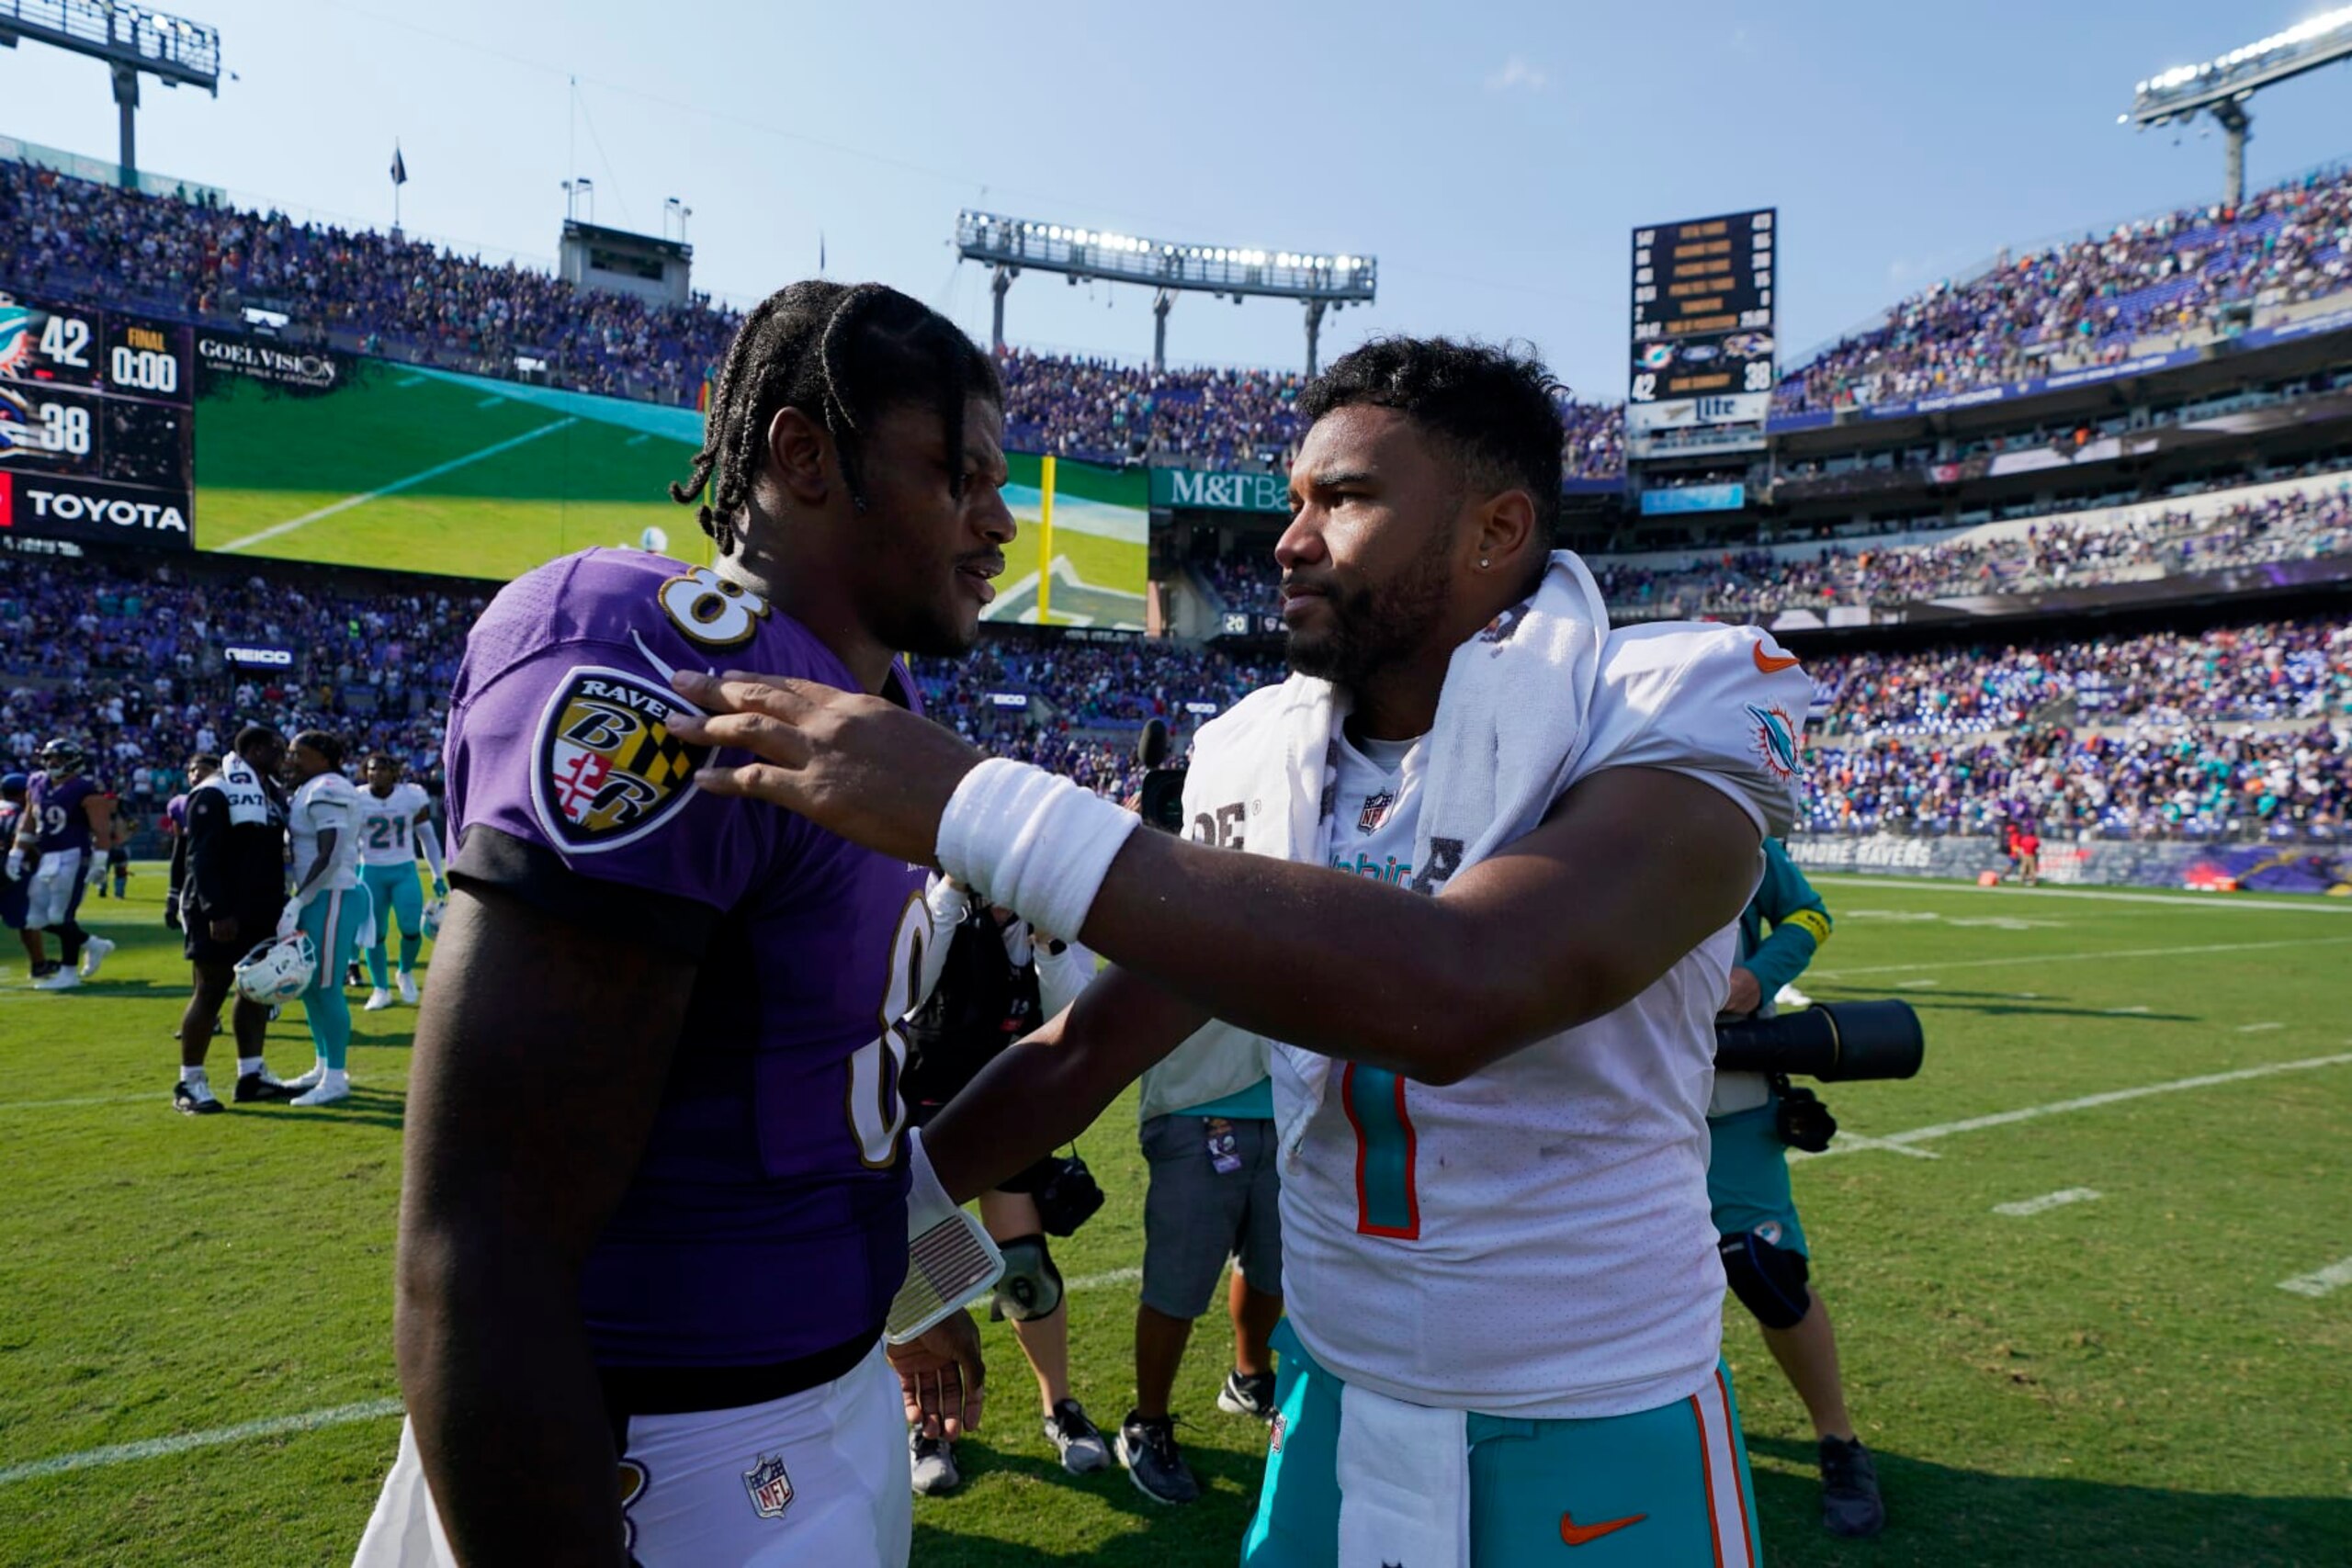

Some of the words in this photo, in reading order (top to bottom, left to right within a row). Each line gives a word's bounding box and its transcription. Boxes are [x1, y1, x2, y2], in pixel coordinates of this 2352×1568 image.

[40, 315, 90, 367] 42
[127, 327, 165, 351] FINAL
[112, 347, 176, 393] 0:00
[198, 338, 259, 366] GOEL
[260, 348, 336, 380] VISION
[1744, 361, 1771, 391] 38
[1632, 373, 1657, 401] 42
[40, 402, 90, 456] 38
[1171, 470, 1251, 507] M&T
[27, 489, 187, 533] TOYOTA
[658, 565, 771, 647] 8
[367, 815, 407, 851] 21
[758, 1478, 790, 1508] NFL
